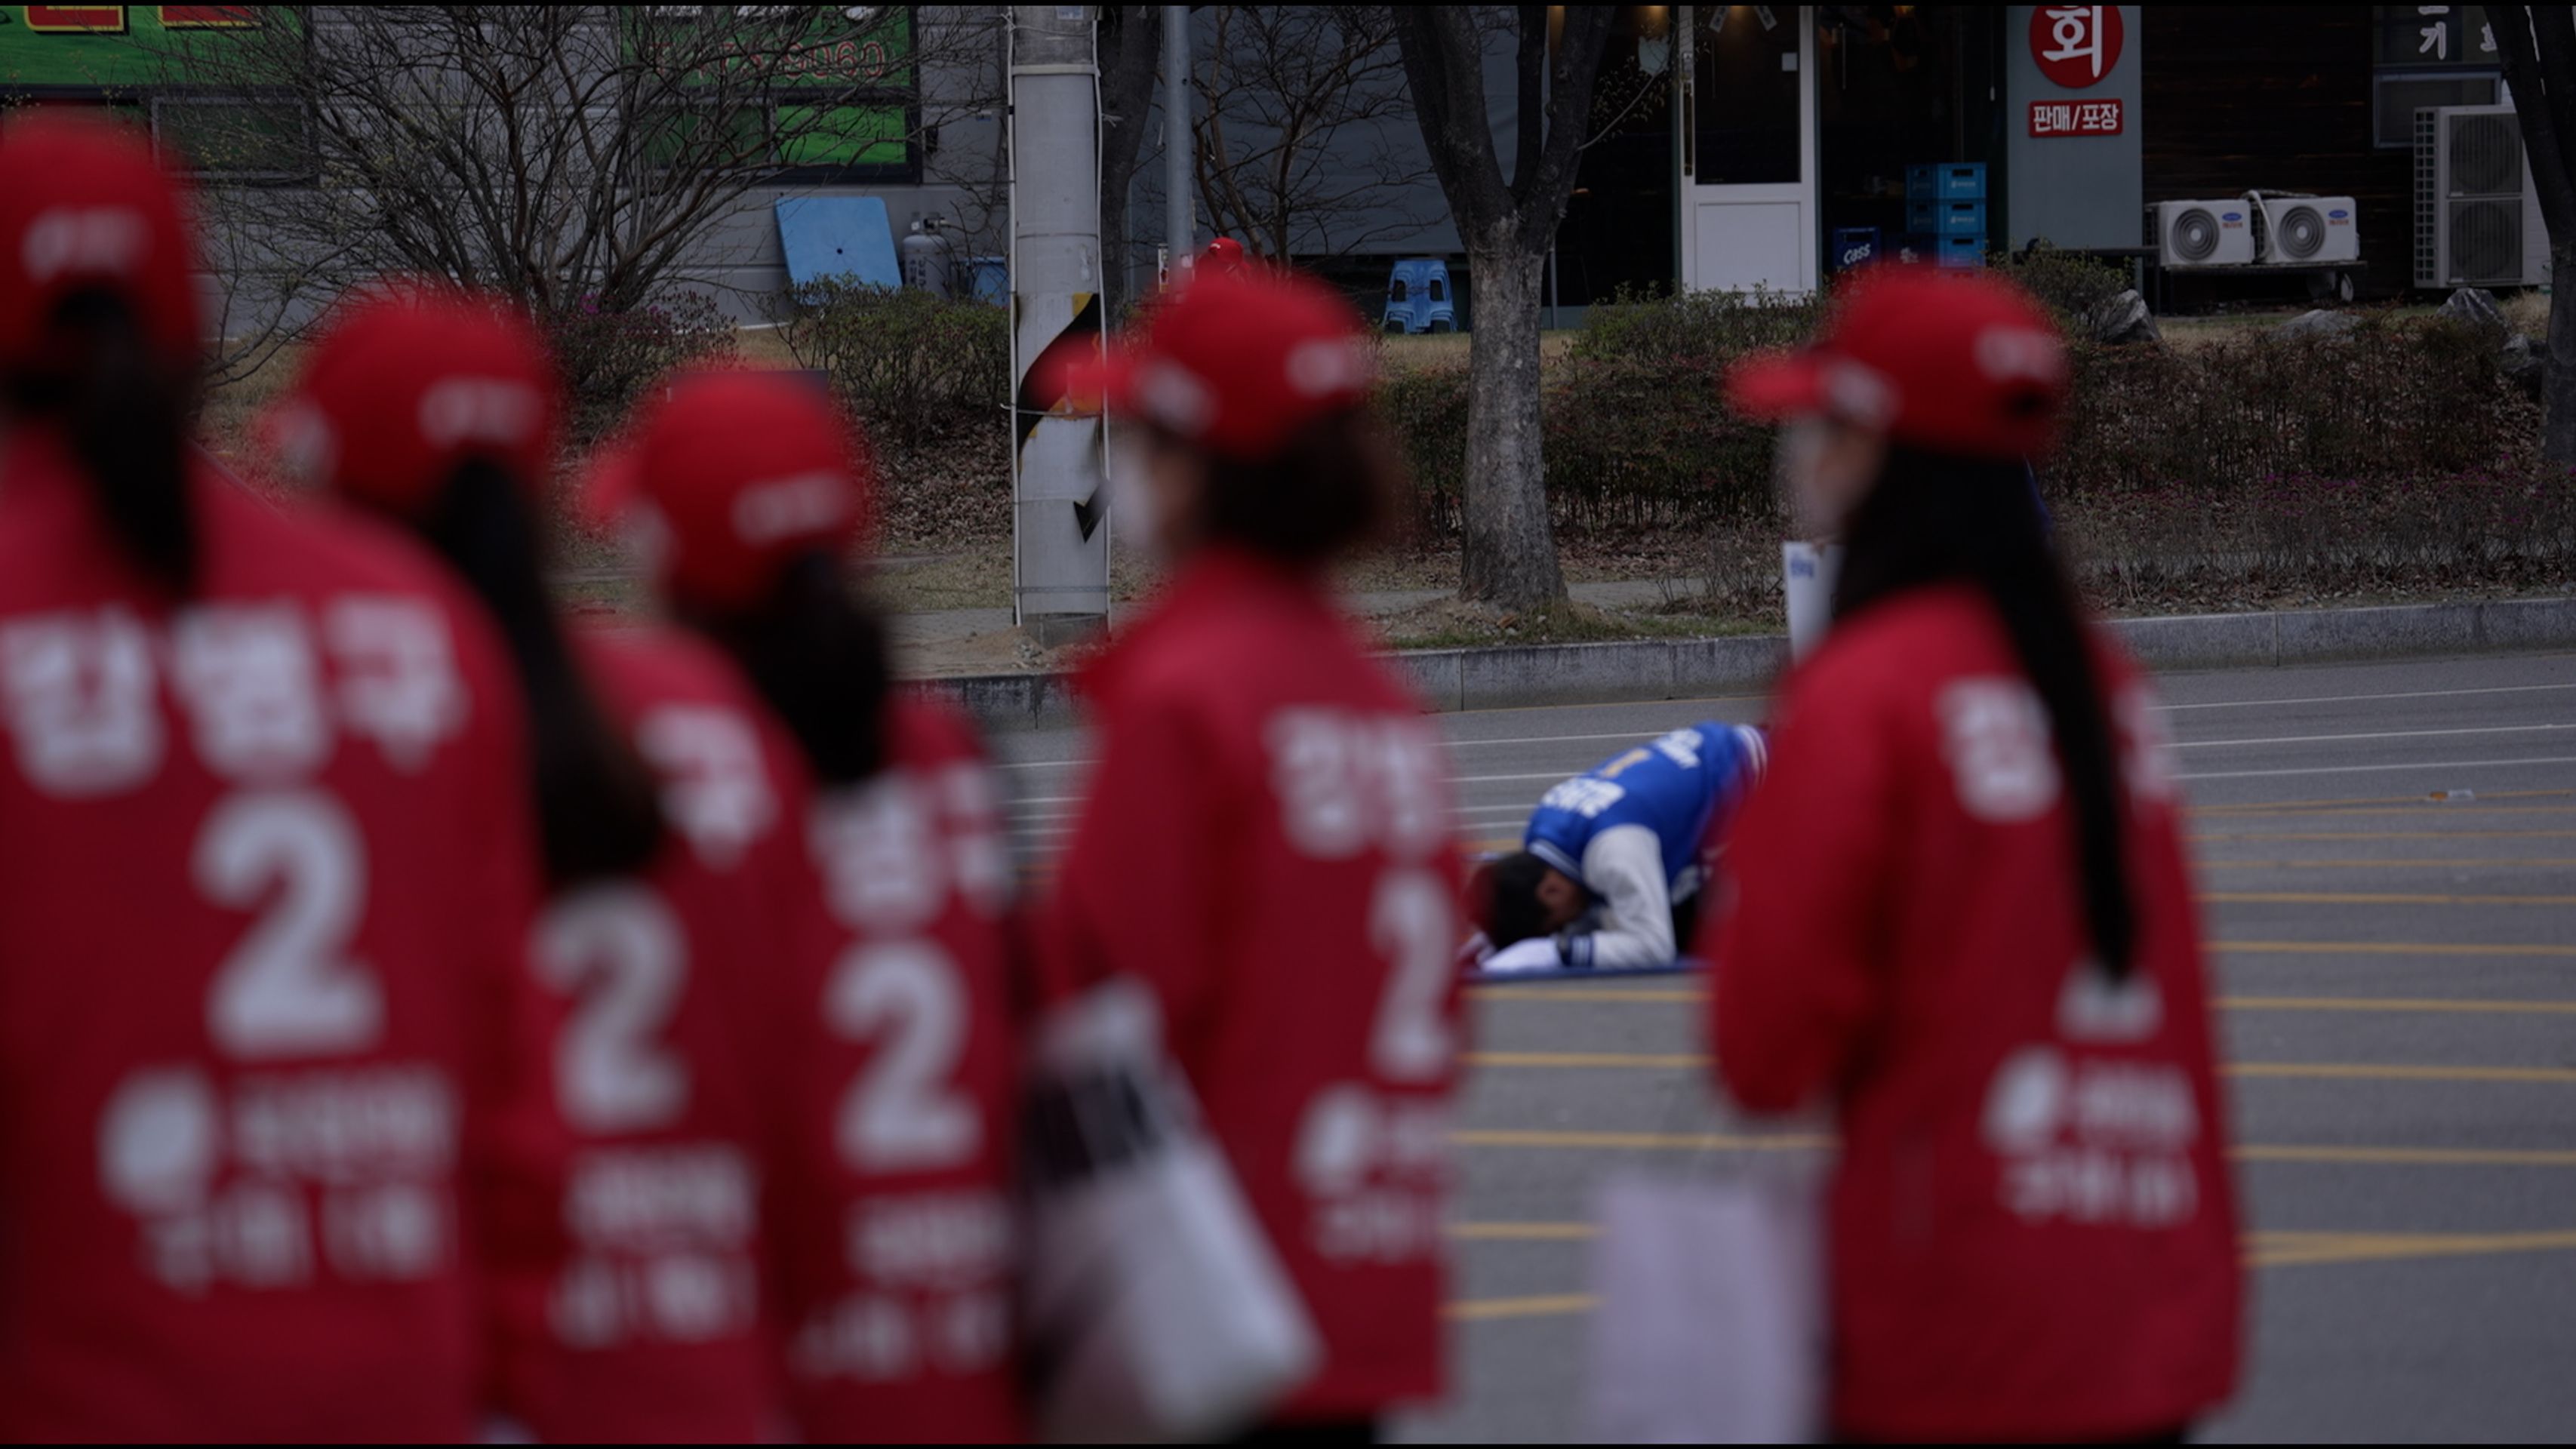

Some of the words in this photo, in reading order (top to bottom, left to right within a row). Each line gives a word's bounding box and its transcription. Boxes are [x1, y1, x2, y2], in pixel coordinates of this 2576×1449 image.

[2033, 103, 2119, 133] 판매/포장
[2042, 5, 2103, 78] 회
[190, 782, 370, 1060] 2
[527, 874, 692, 1134] 2
[1365, 865, 1458, 1082] 2
[820, 934, 985, 1174] 2
